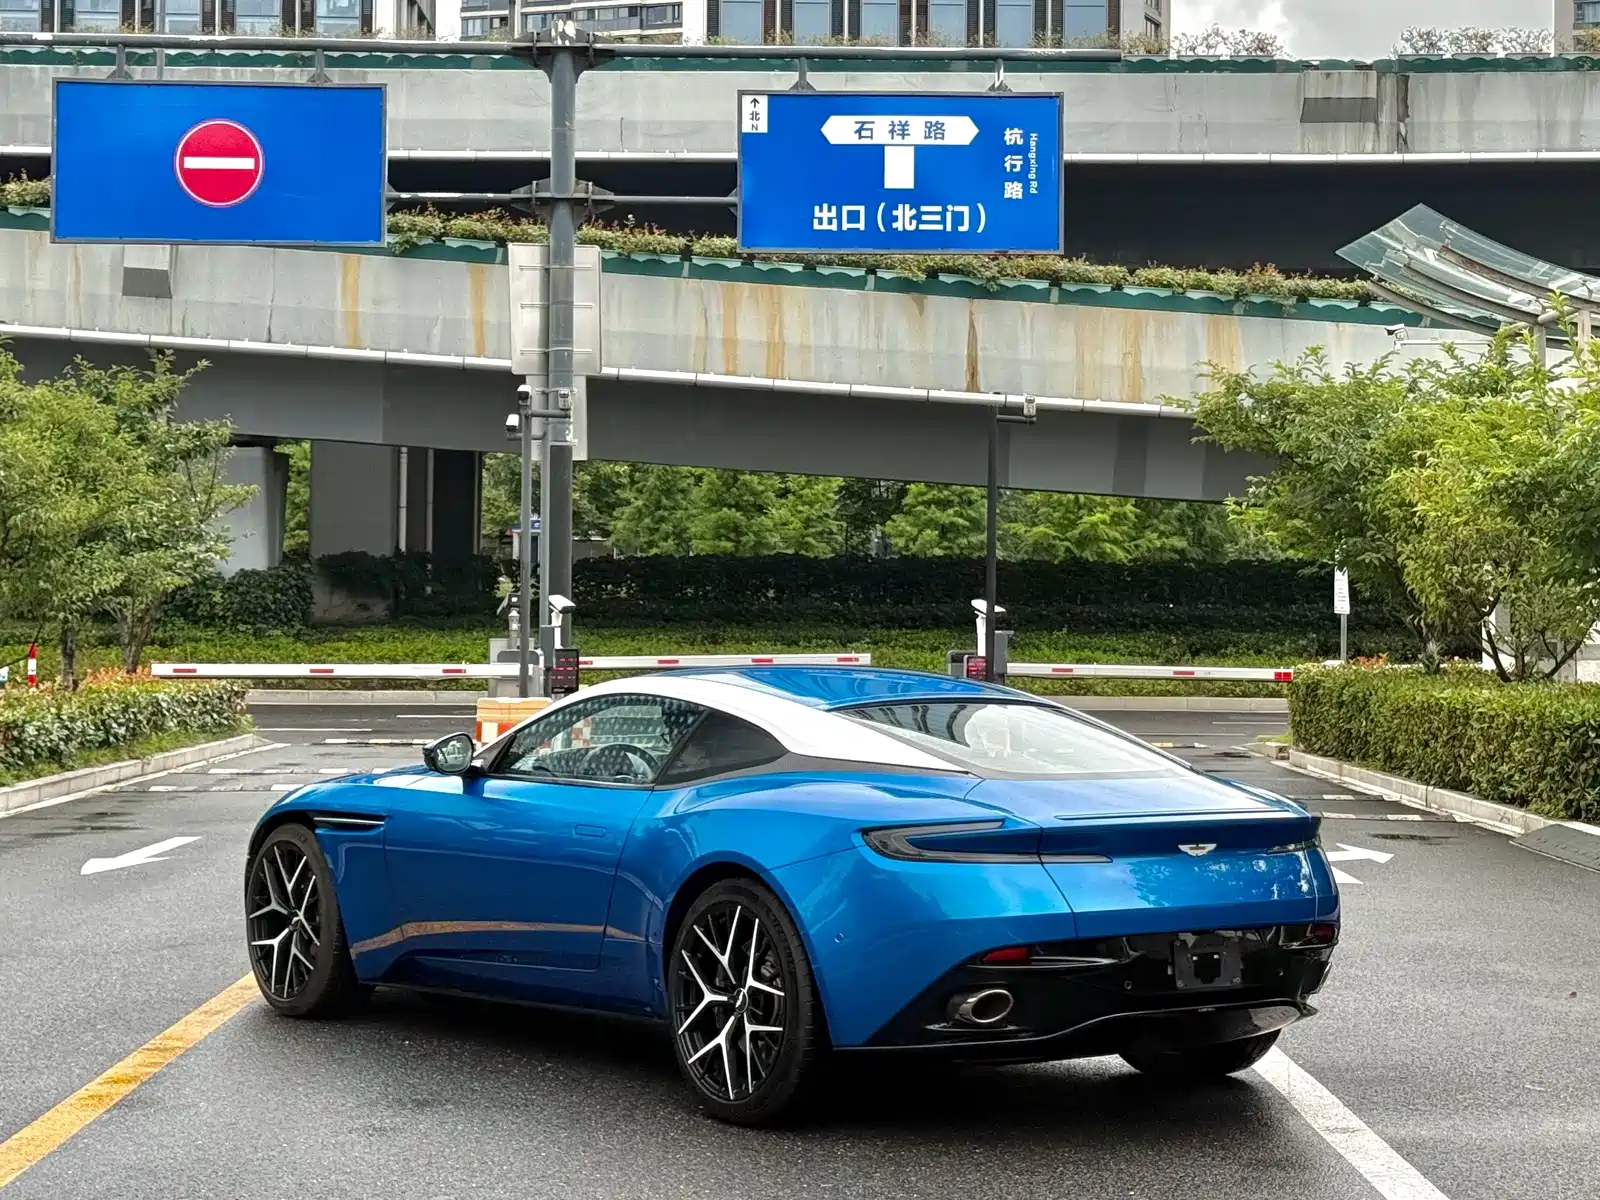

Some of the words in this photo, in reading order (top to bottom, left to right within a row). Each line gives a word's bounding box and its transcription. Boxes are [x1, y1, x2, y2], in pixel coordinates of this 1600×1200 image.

[749, 110, 761, 122] 北
[751, 123, 759, 131] N
[854, 120, 946, 141] 石祥路
[1003, 127, 1024, 200] 杭行路
[1027, 132, 1039, 180] Hangxing
[1029, 180, 1039, 194] Rd
